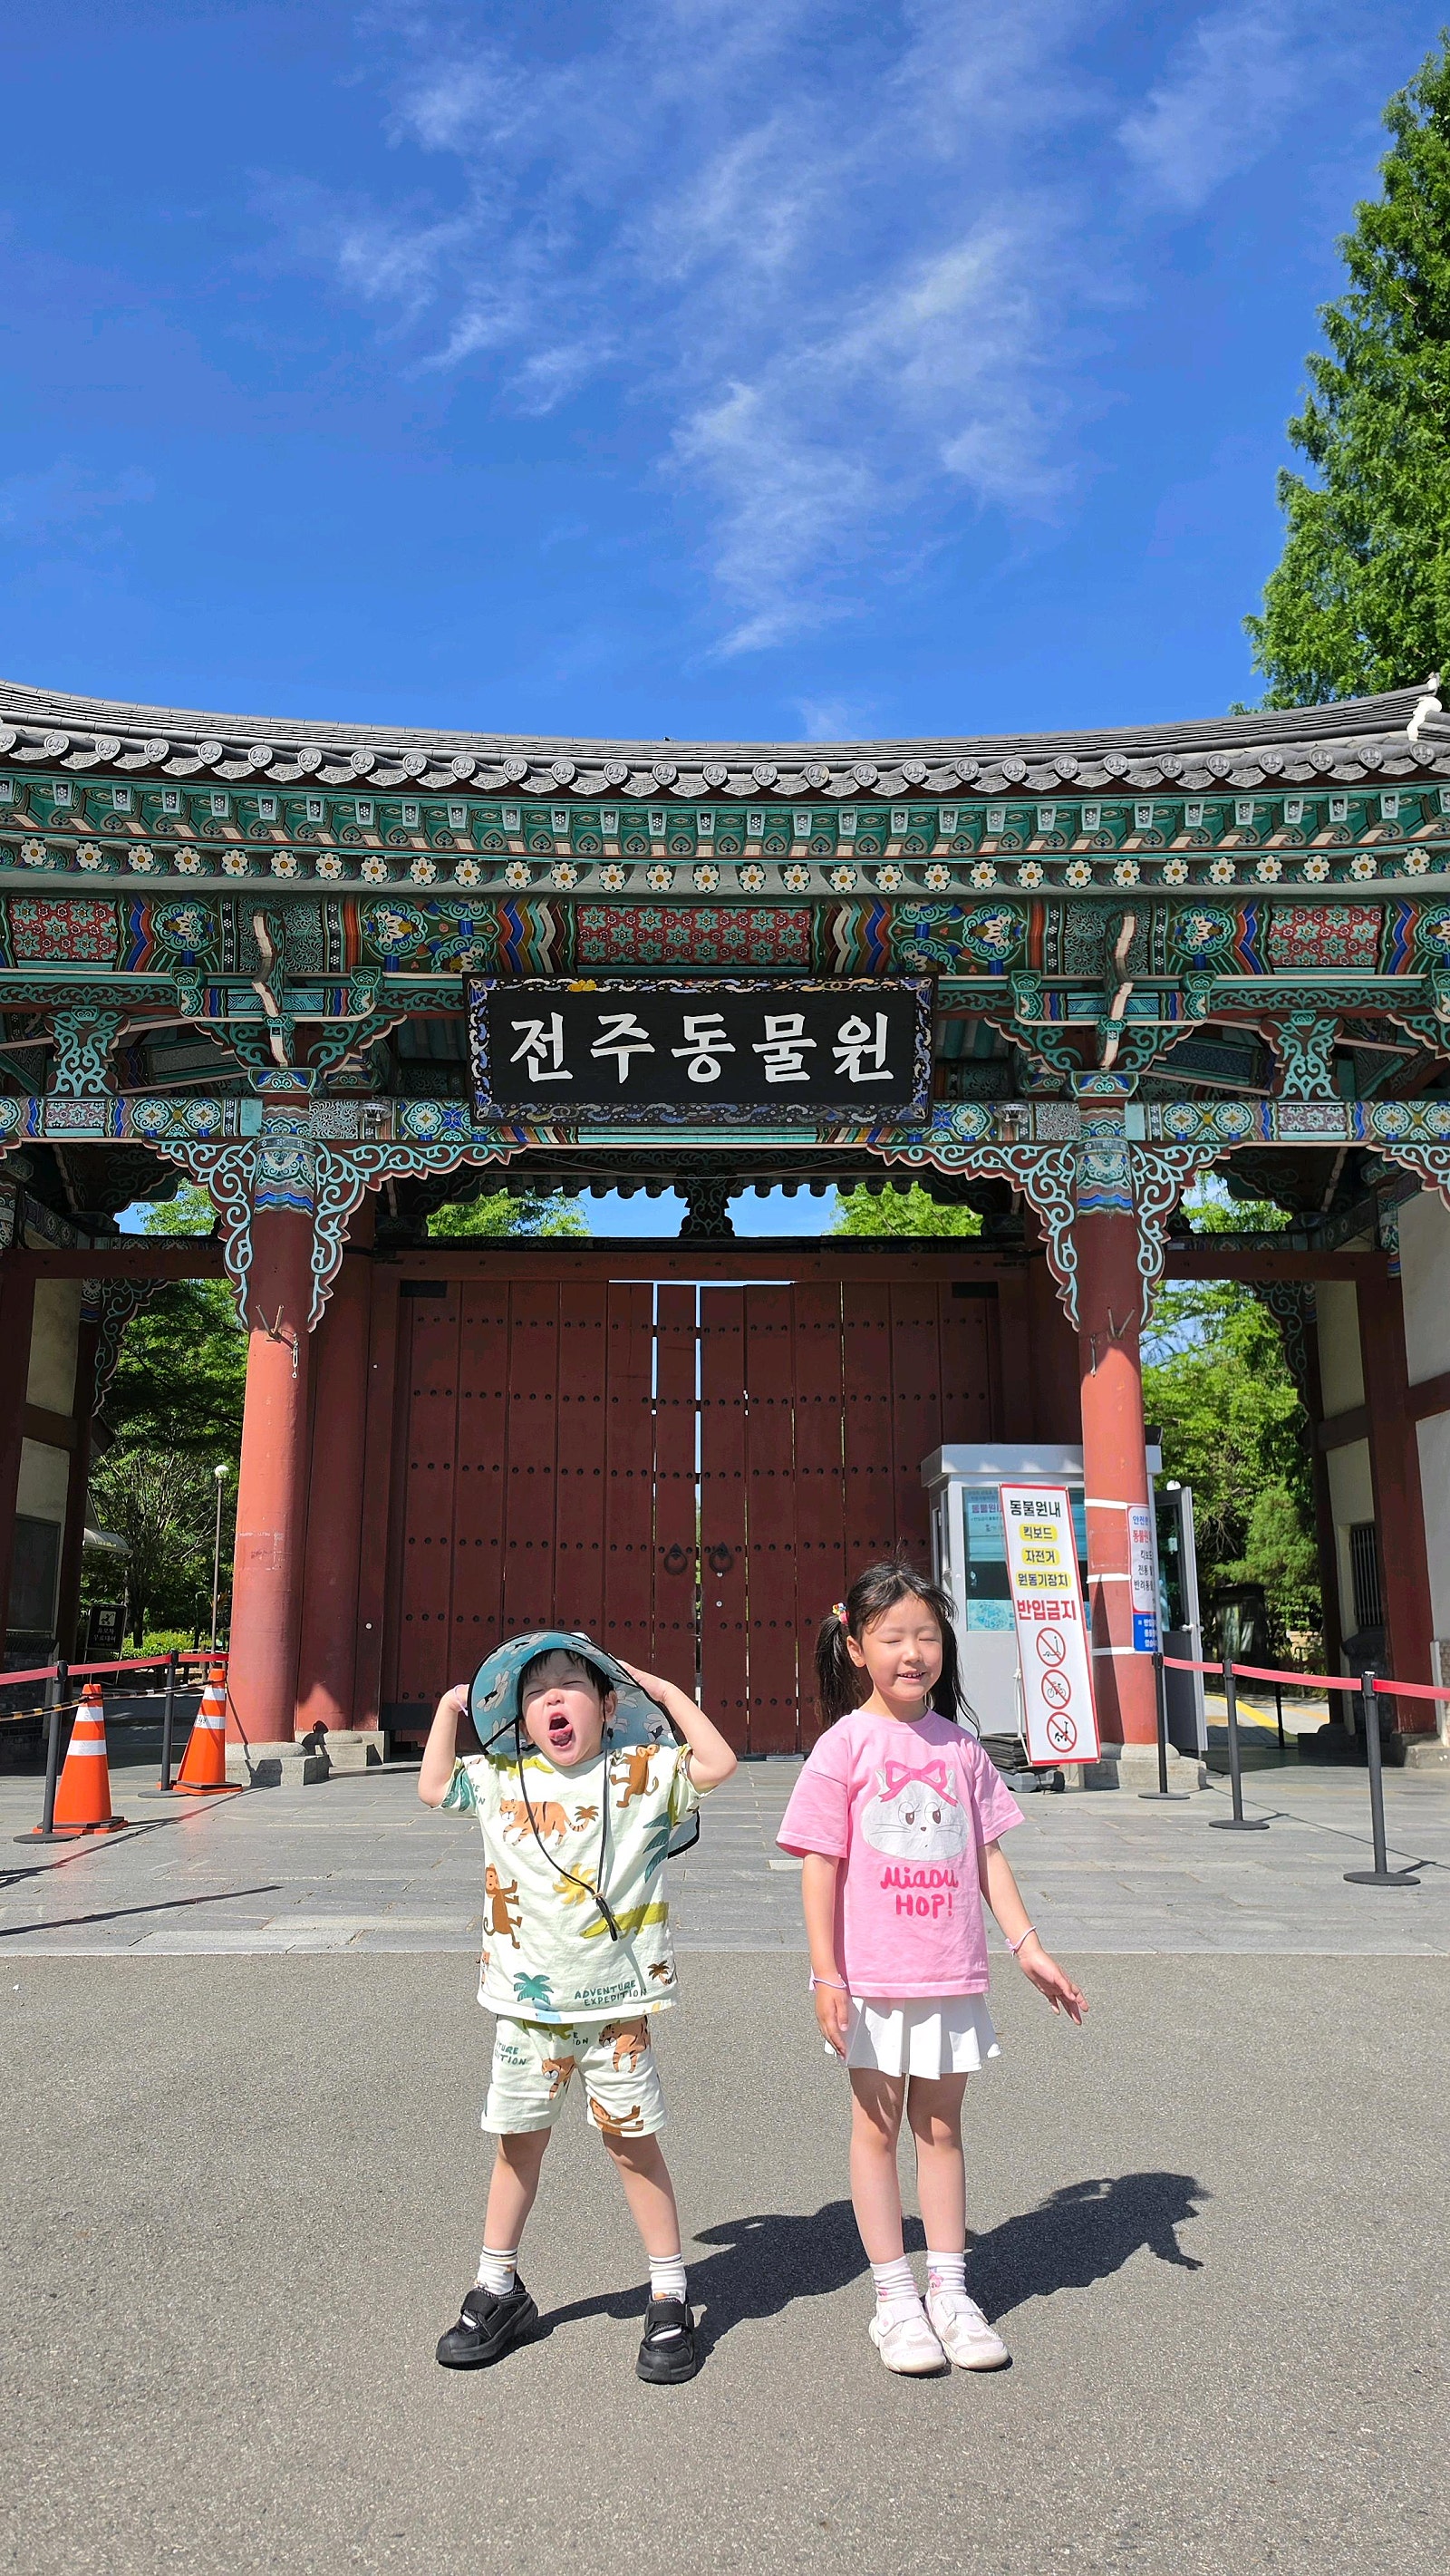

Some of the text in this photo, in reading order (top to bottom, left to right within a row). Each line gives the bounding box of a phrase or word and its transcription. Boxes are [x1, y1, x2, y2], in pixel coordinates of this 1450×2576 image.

[510, 1012, 894, 1084] 전주동물원
[1010, 1499, 1061, 1518] 동물원내
[1023, 1526, 1053, 1539] 킥보드
[1025, 1550, 1055, 1564] 자전거
[1018, 1574, 1068, 1587] 원동기장치
[1016, 1599, 1077, 1621] 반입금지
[880, 1866, 959, 1890] Miaou
[895, 1892, 952, 1919] HOP!
[575, 1980, 636, 2000] ADVENTURE
[584, 1988, 647, 2007] EXPEDITION
